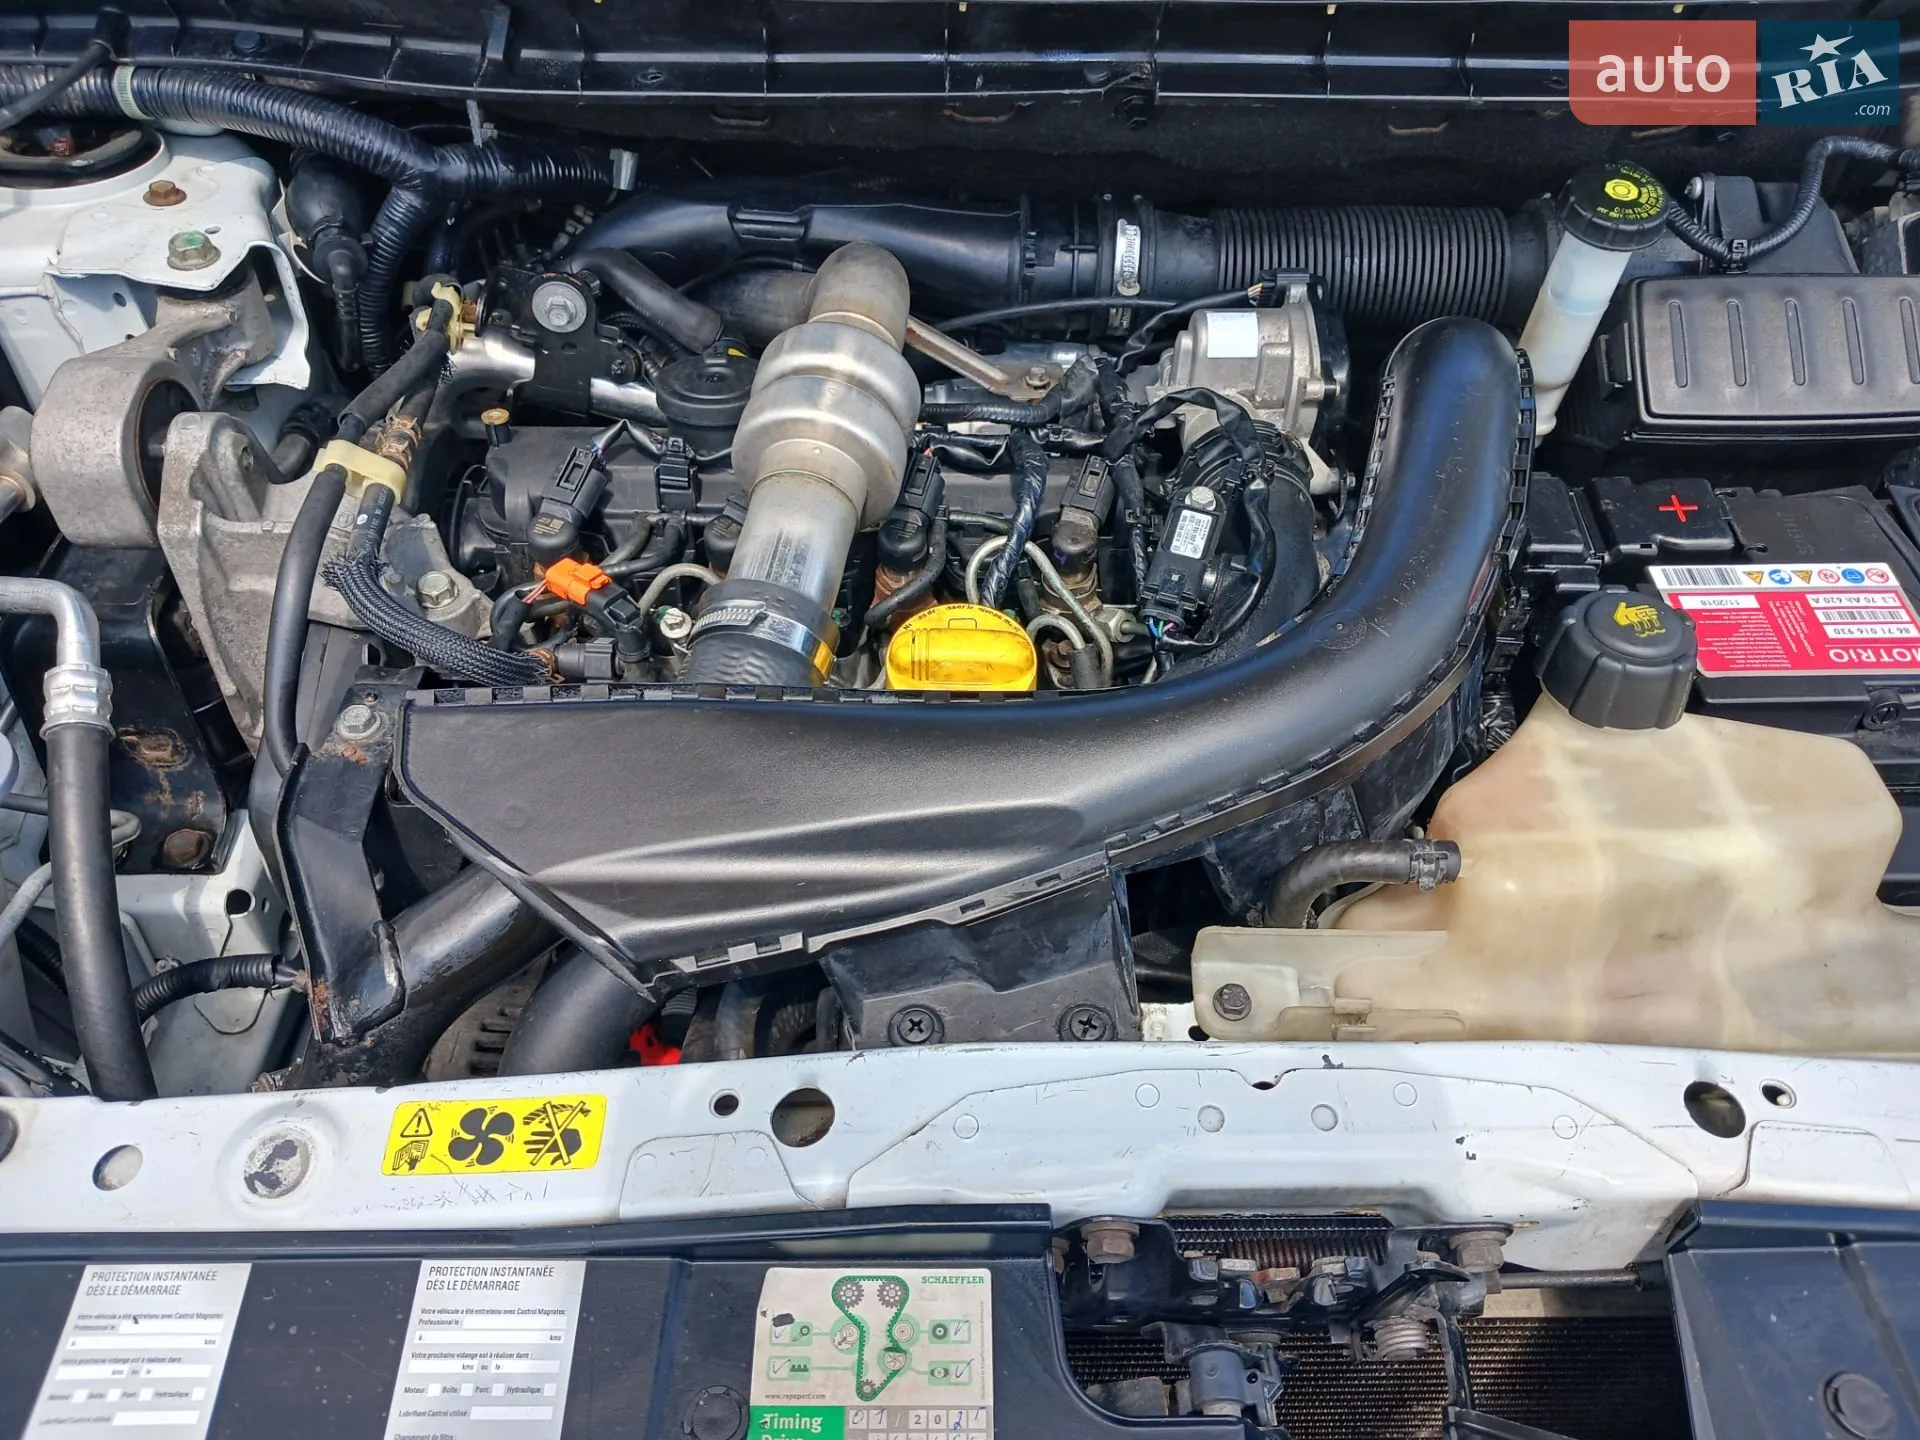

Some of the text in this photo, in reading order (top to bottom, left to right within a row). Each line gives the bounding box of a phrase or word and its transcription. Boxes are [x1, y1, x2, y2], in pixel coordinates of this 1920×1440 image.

[91, 1269, 218, 1282] PROTECTION INSTANTANÉE
[428, 1265, 555, 1277] PROTECTION INSTANTANÉE
[426, 1279, 520, 1291] DÈS LE DÉMARRAGE
[921, 1275, 985, 1284] SCHAEFFLER
[107, 1286, 119, 1296] LE
[120, 1283, 182, 1296] DÉMARRAGE
[761, 1412, 823, 1433] Timing
